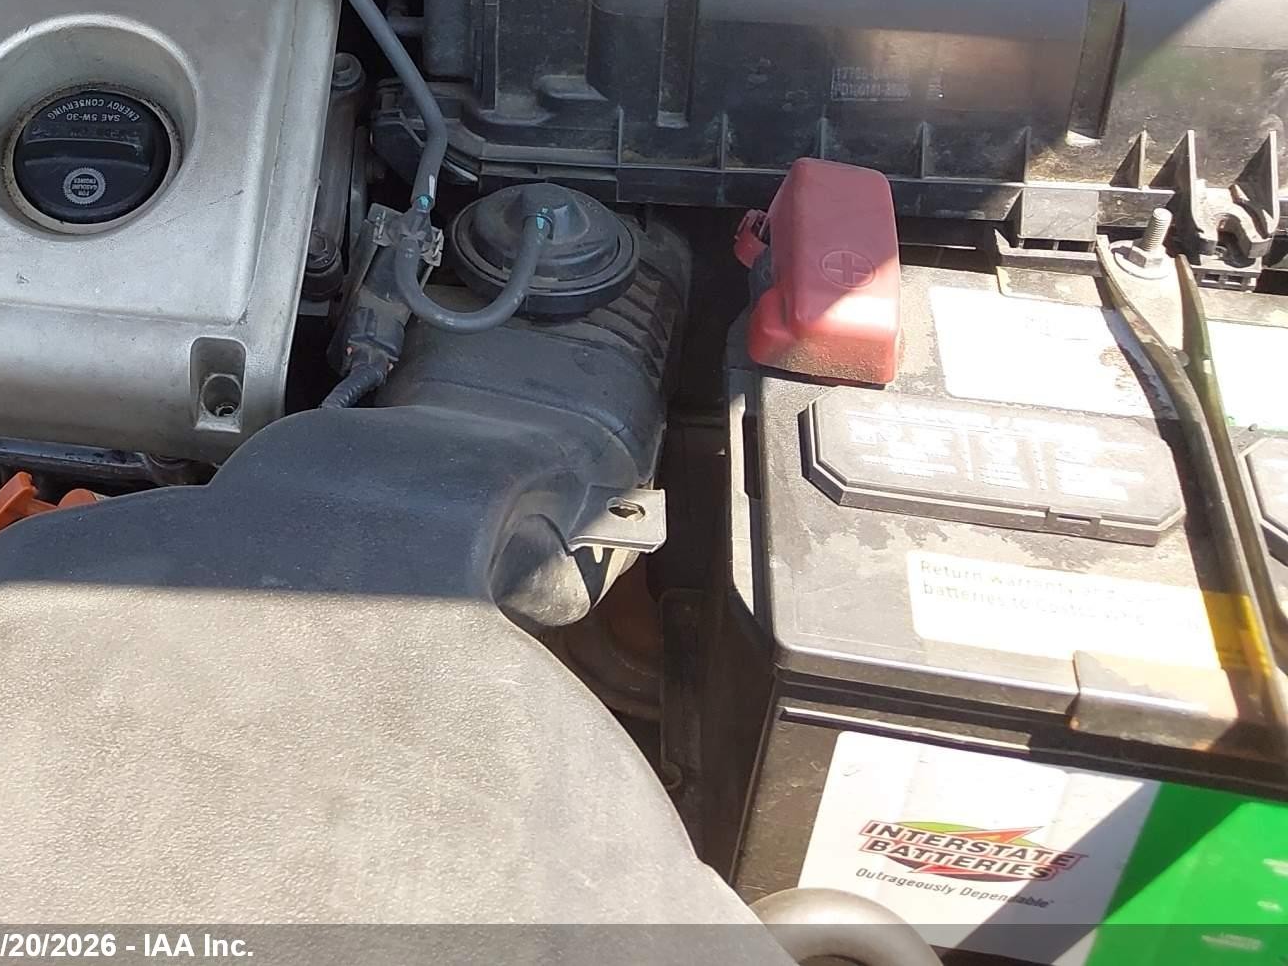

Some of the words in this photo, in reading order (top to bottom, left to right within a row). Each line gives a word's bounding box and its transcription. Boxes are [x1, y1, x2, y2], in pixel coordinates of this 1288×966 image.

[47, 98, 105, 120] CONSERVING
[66, 113, 98, 122] 5W-30
[101, 114, 121, 122] SAE
[106, 100, 141, 123] ENERGY
[865, 822, 1076, 868] INTERSTATE
[867, 838, 1054, 880] BATTERIES
[855, 867, 957, 895] Outrageously
[959, 886, 1051, 909] Dependable
